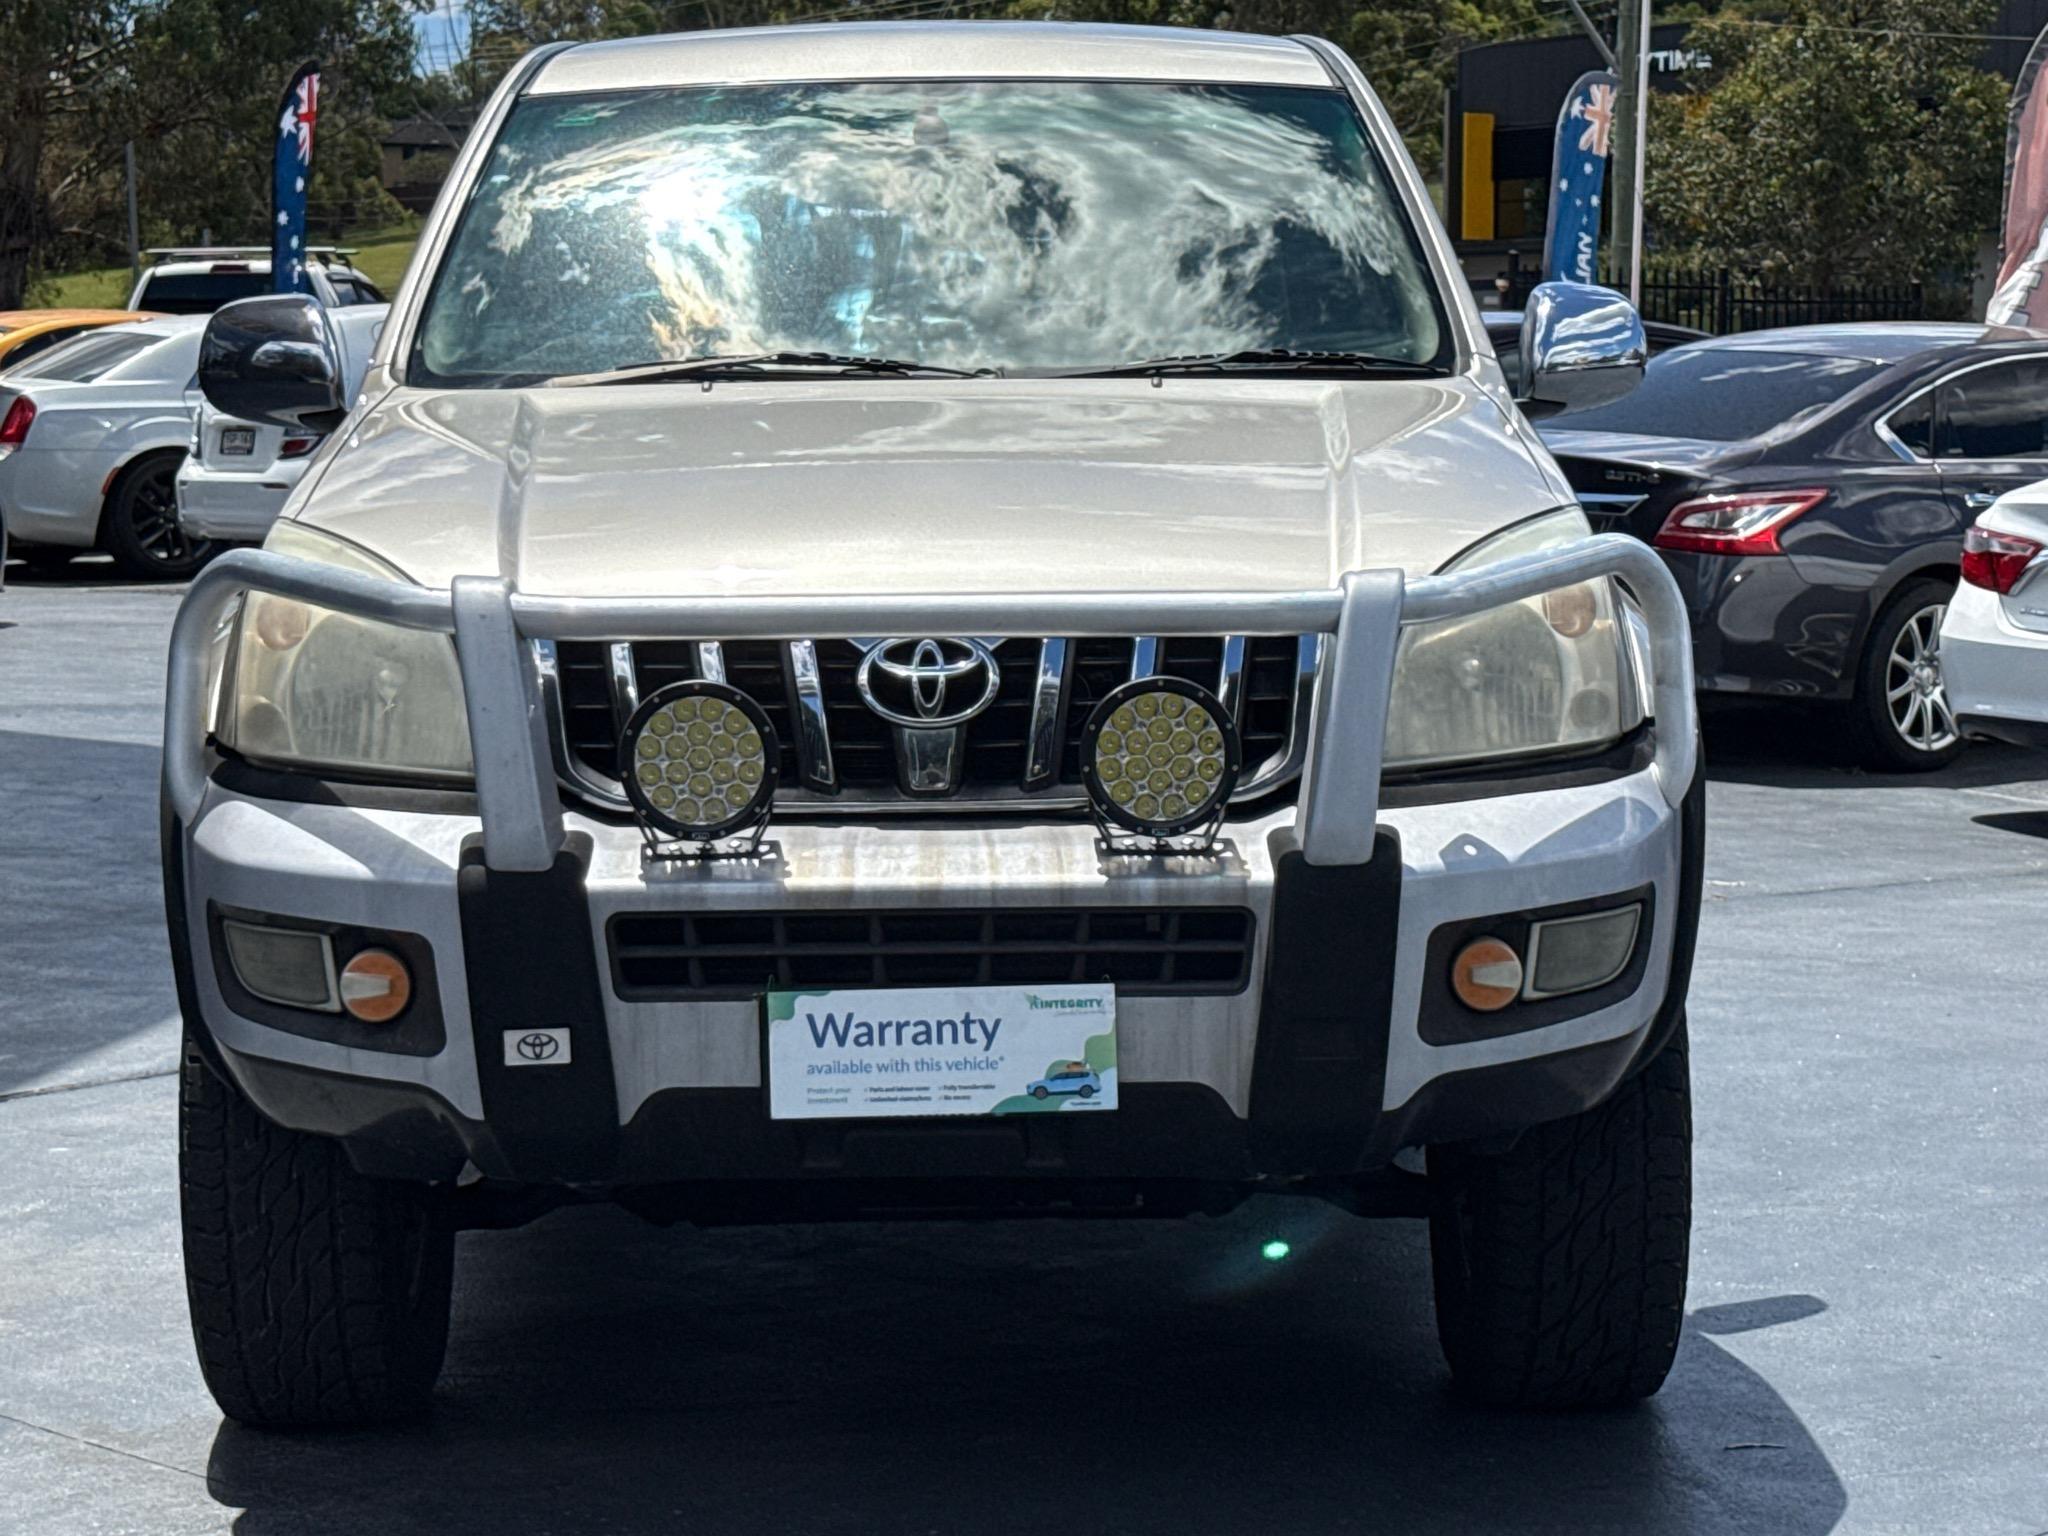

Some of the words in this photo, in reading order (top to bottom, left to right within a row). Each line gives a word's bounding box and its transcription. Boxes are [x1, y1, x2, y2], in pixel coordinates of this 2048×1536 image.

[1041, 998, 1104, 1009] INTEGRITY
[806, 1011, 1002, 1052] Warranty
[807, 1058, 873, 1075] available
[876, 1057, 911, 1073] with
[914, 1057, 942, 1072] this
